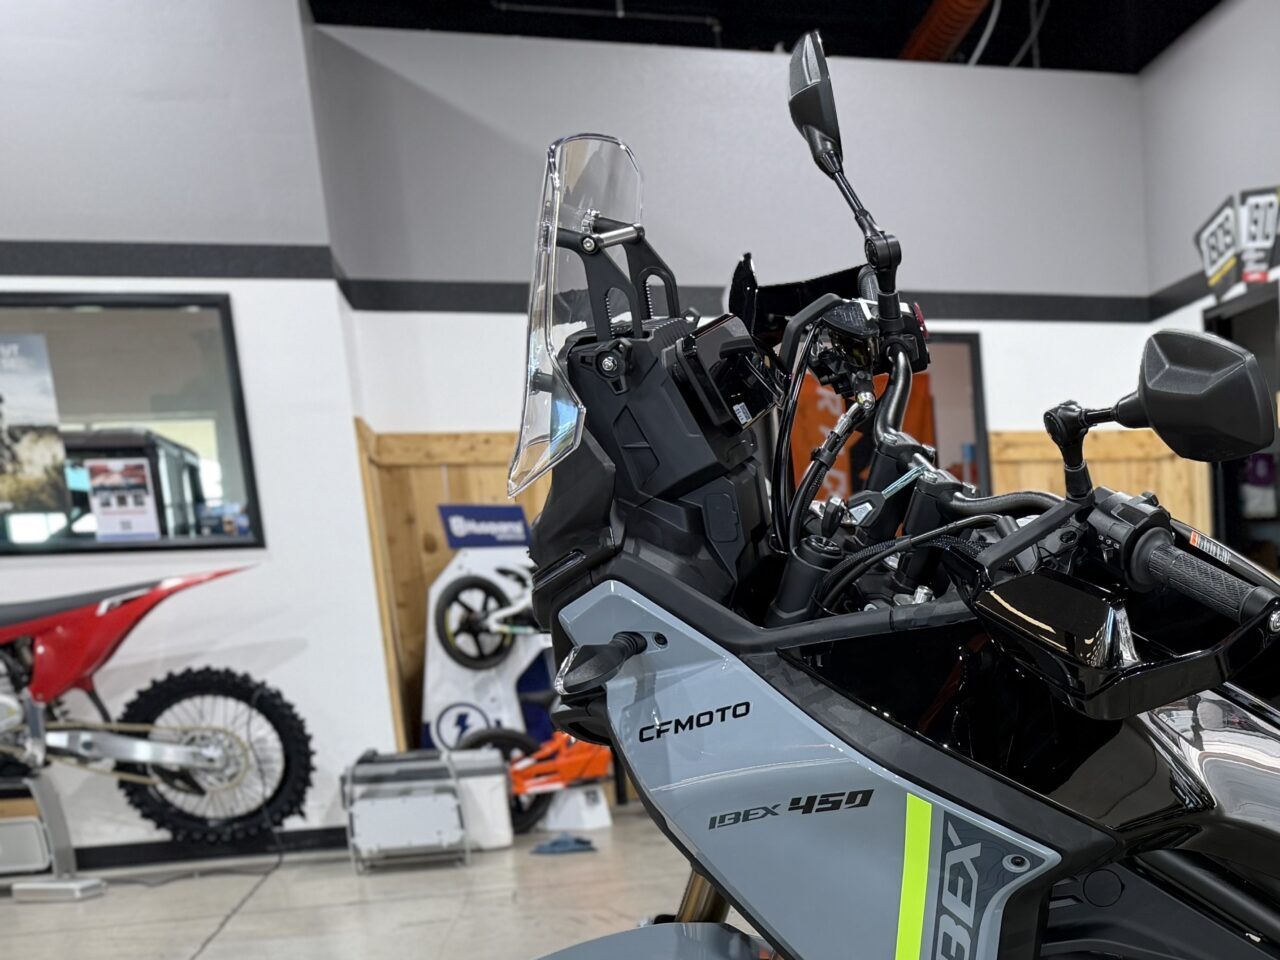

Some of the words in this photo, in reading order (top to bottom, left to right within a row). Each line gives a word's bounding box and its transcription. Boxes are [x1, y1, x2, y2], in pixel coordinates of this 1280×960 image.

[638, 701, 751, 743] CFMOTO
[708, 802, 781, 830] IBEX
[787, 788, 875, 815] 450
